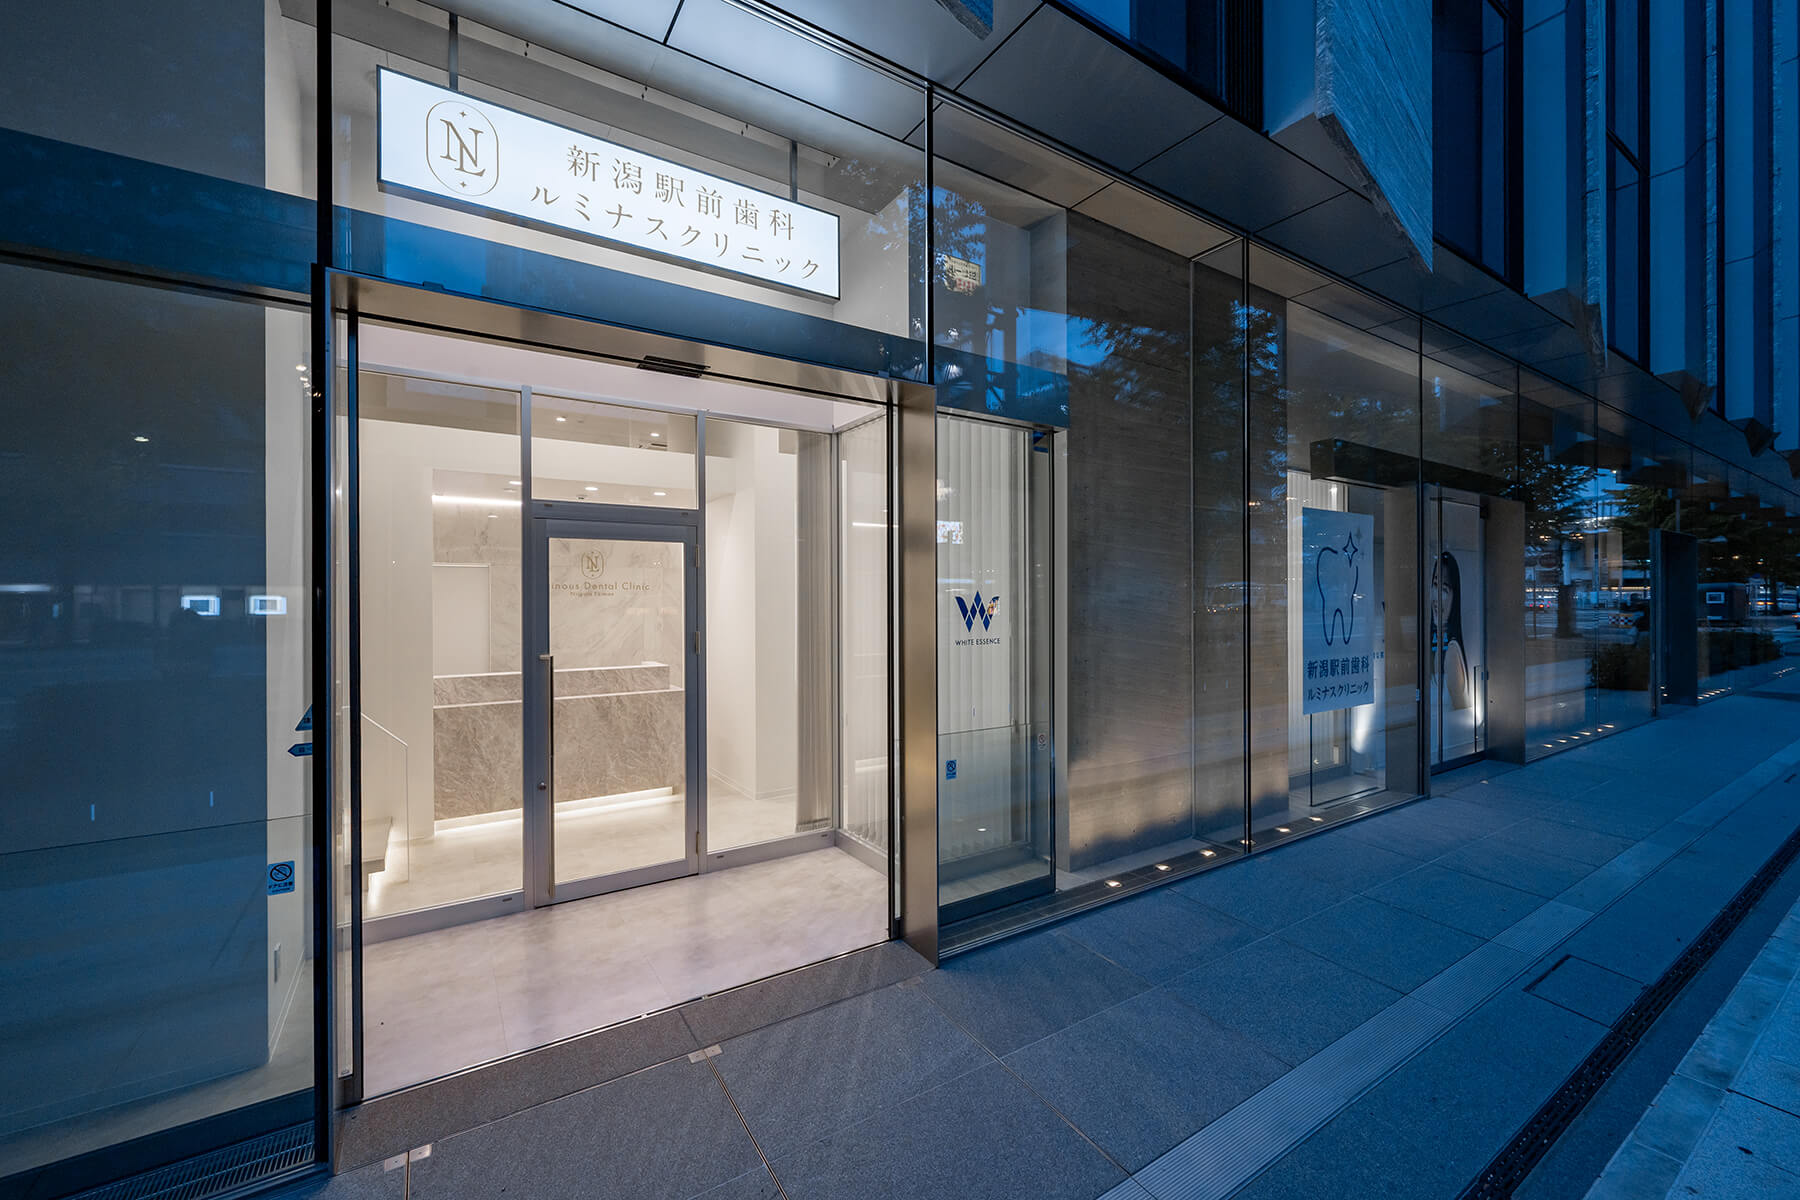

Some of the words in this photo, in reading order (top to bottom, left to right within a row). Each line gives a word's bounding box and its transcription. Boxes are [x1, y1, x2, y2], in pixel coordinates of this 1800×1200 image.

[566, 144, 795, 241] 新潟駅前歯科
[530, 184, 819, 280] ルミナスクリニック
[584, 581, 618, 590] Dental
[622, 581, 650, 591] Clinic
[976, 638, 1000, 646] ESSENCE
[1307, 656, 1369, 679] 新潟駅前歯科
[1307, 681, 1369, 701] ルミナスクリニック
